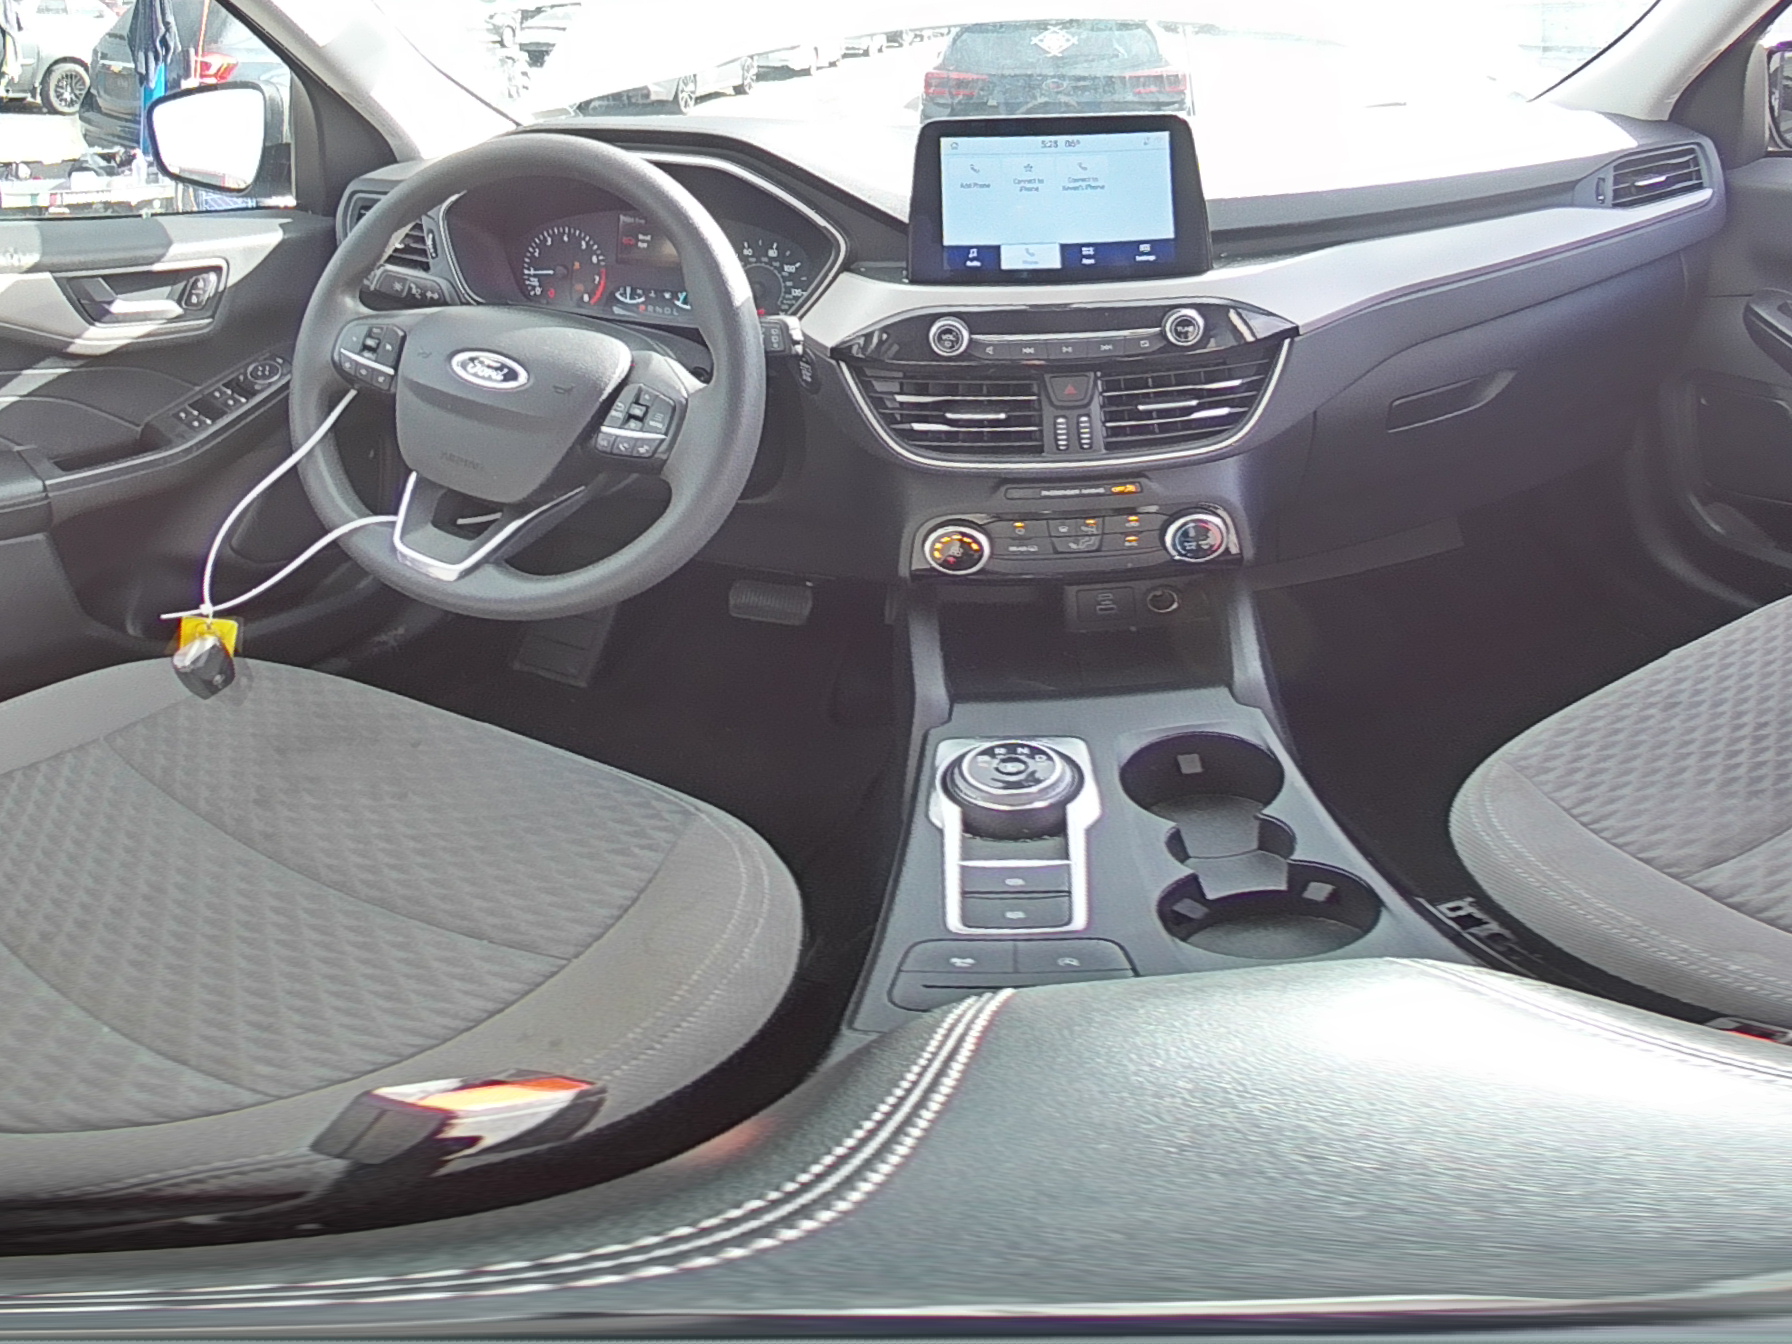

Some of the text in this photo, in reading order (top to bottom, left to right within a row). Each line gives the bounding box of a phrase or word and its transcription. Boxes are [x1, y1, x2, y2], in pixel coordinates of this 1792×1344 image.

[783, 264, 796, 273] 100
[941, 333, 956, 341] VOL
[1016, 747, 1031, 755] N
